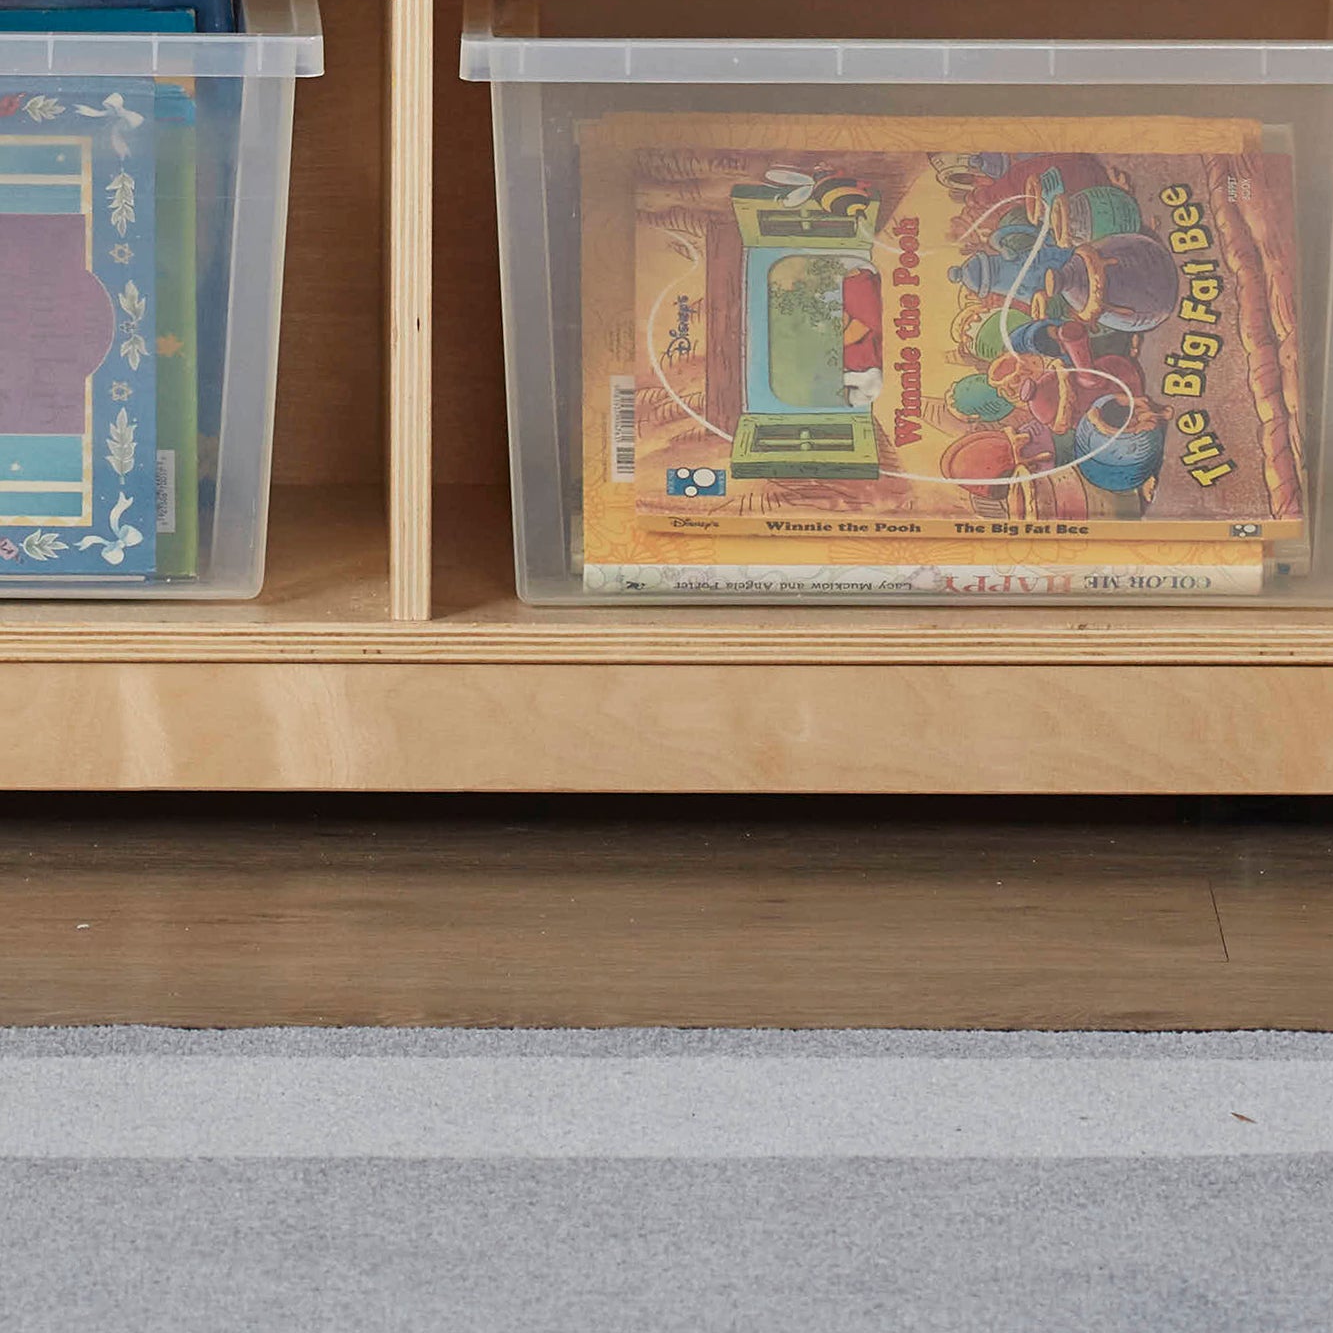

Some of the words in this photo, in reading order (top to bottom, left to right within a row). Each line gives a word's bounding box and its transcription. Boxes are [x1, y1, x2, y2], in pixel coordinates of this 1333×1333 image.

[1159, 183, 1214, 254] Bee
[892, 216, 920, 286] Pooh
[1179, 259, 1223, 324] Fat
[893, 293, 921, 340] the
[1162, 332, 1222, 397] Big
[894, 346, 922, 447] Winnie
[1177, 409, 1237, 487] The
[765, 520, 833, 533] Winnie
[838, 521, 870, 533] the
[874, 522, 921, 533] Pooh
[954, 523, 985, 534] The
[991, 523, 1019, 536] Big
[1025, 523, 1051, 535] Fat
[1056, 524, 1089, 535] Bee
[779, 581, 805, 592] and
[943, 574, 1072, 594] HAPPY
[1083, 574, 1121, 590] ME
[1129, 574, 1212, 590] COLOR
